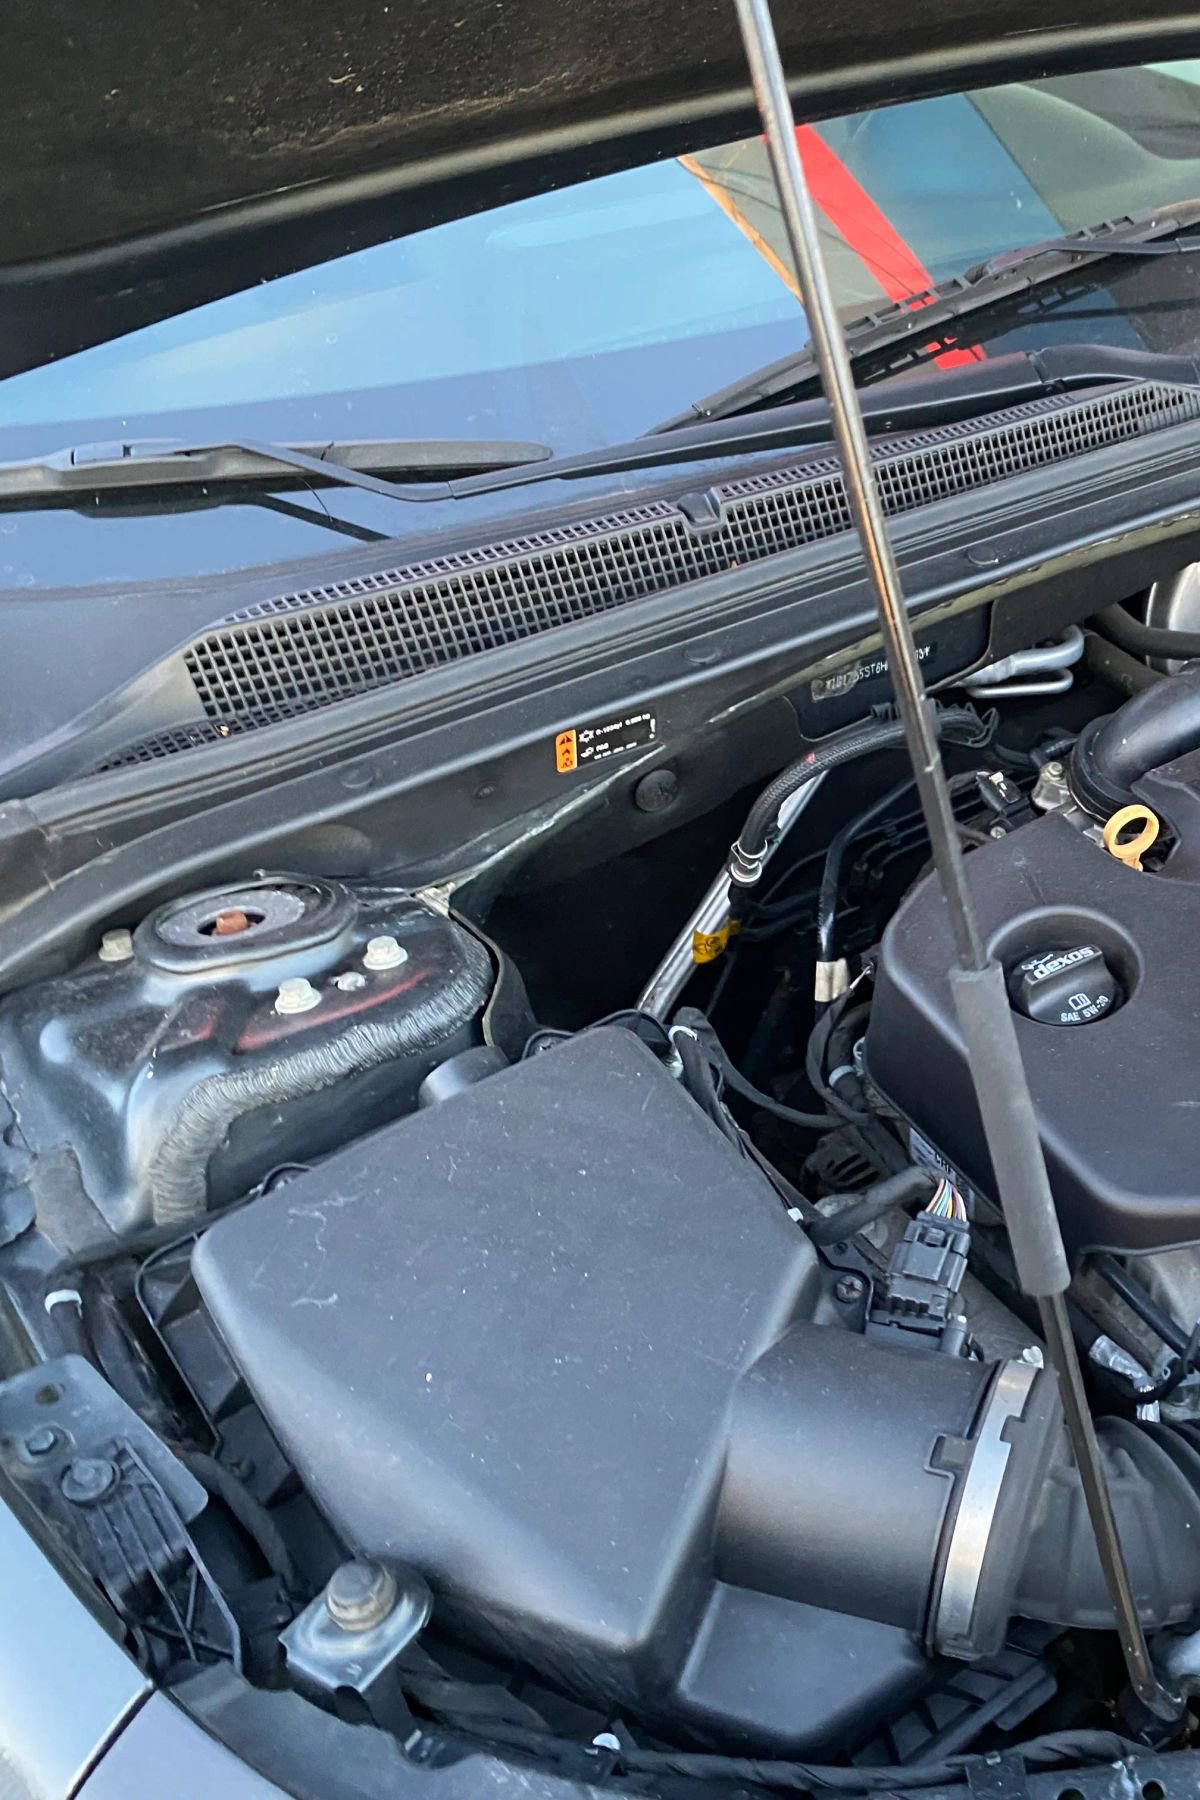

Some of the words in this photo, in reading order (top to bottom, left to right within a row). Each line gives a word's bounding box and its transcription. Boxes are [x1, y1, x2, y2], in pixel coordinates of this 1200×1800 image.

[1033, 946, 1095, 979] dexos
[1060, 1011, 1081, 1022] SAE
[1082, 995, 1109, 1018] 5W-30
